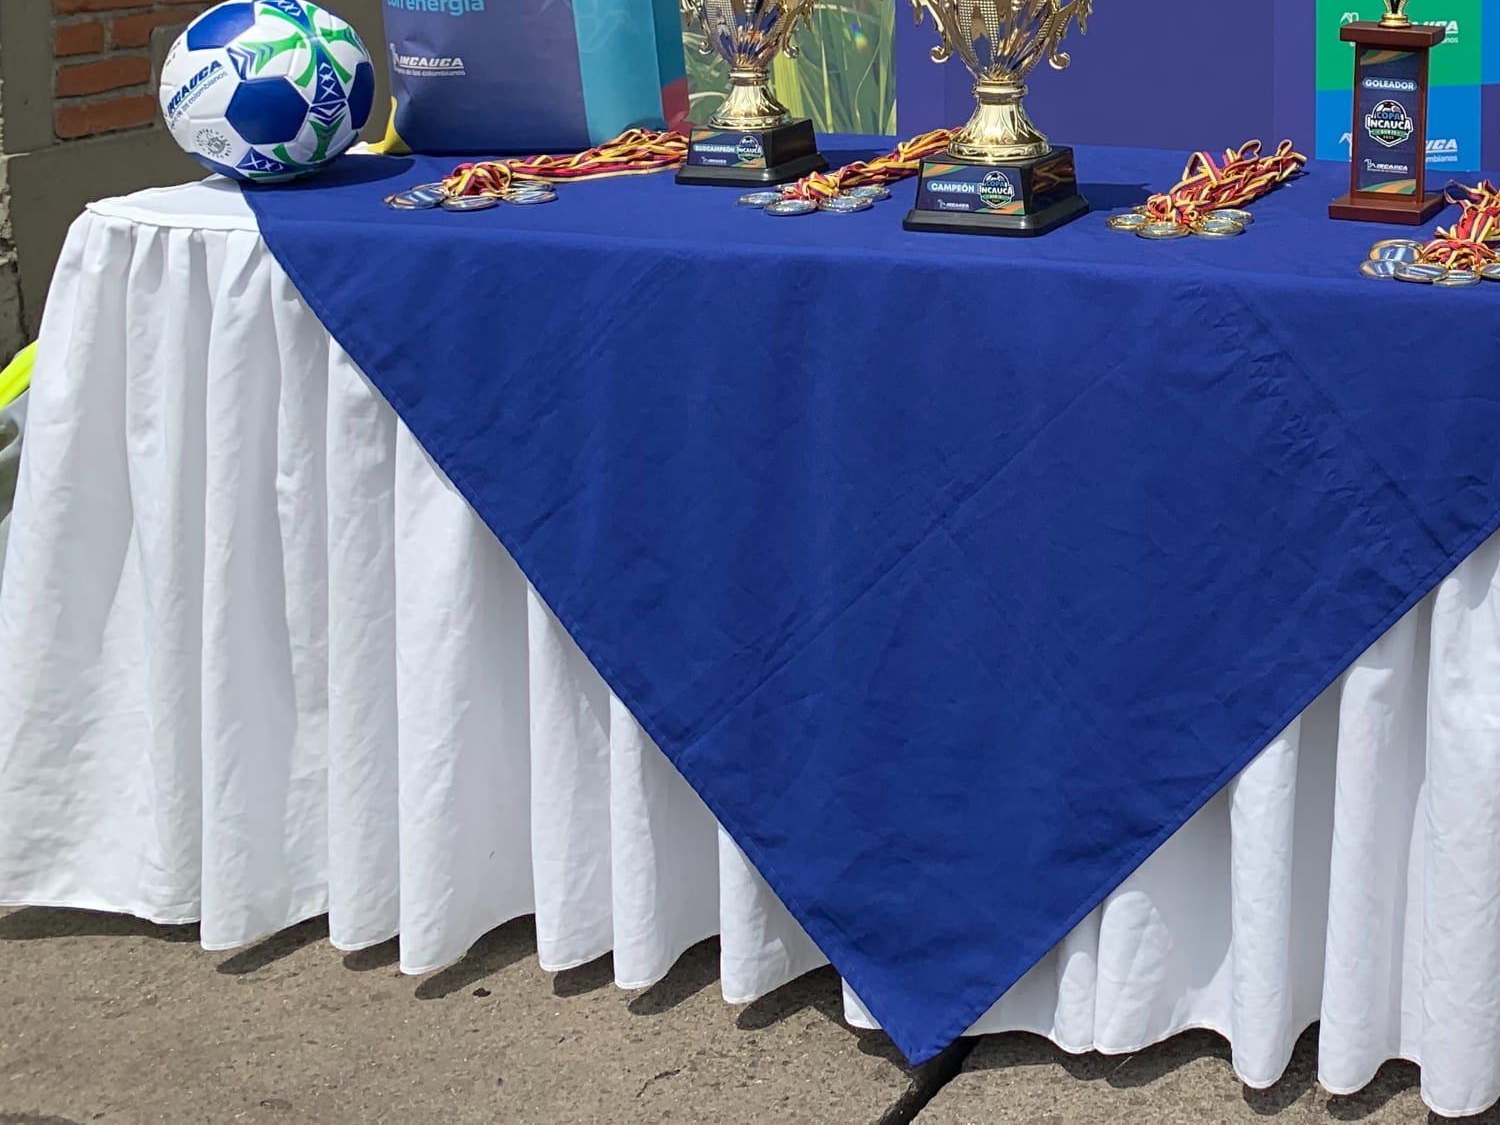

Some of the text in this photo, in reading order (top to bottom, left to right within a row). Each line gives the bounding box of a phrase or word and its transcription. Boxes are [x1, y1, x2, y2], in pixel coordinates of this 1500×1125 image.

[399, 56, 464, 67] INCAUCA
[1365, 79, 1414, 91] GOLEADOR
[1376, 111, 1400, 121] COPA
[1367, 117, 1411, 131] INCAUCA
[931, 183, 975, 192] CAMPEÓN
[979, 185, 1013, 195] INCAUCA
